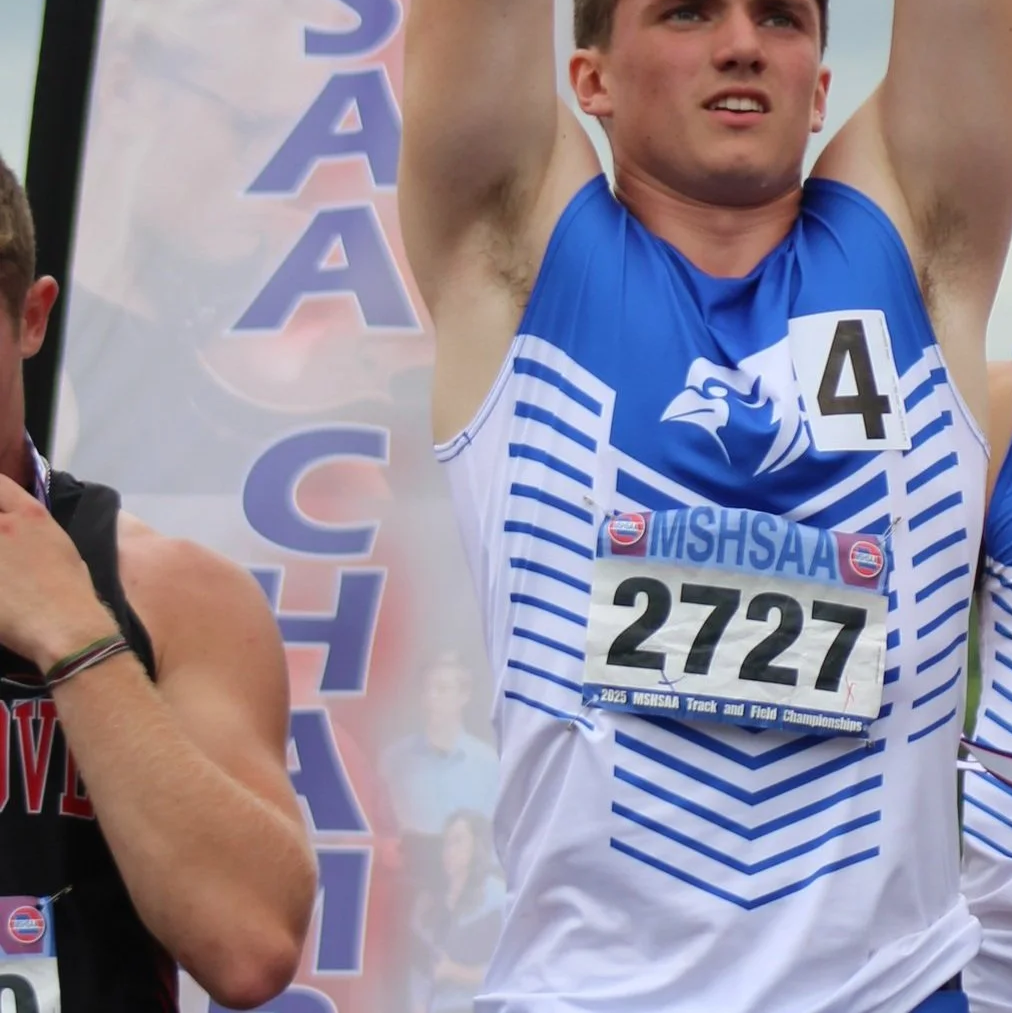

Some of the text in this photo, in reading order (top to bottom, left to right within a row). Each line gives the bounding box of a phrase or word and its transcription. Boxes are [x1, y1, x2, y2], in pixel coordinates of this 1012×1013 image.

[817, 319, 892, 440] 4
[650, 506, 837, 580] MSHSAA
[606, 576, 868, 693] 2727
[601, 688, 863, 733] 2025 MSHSAA Track and Field Championships
